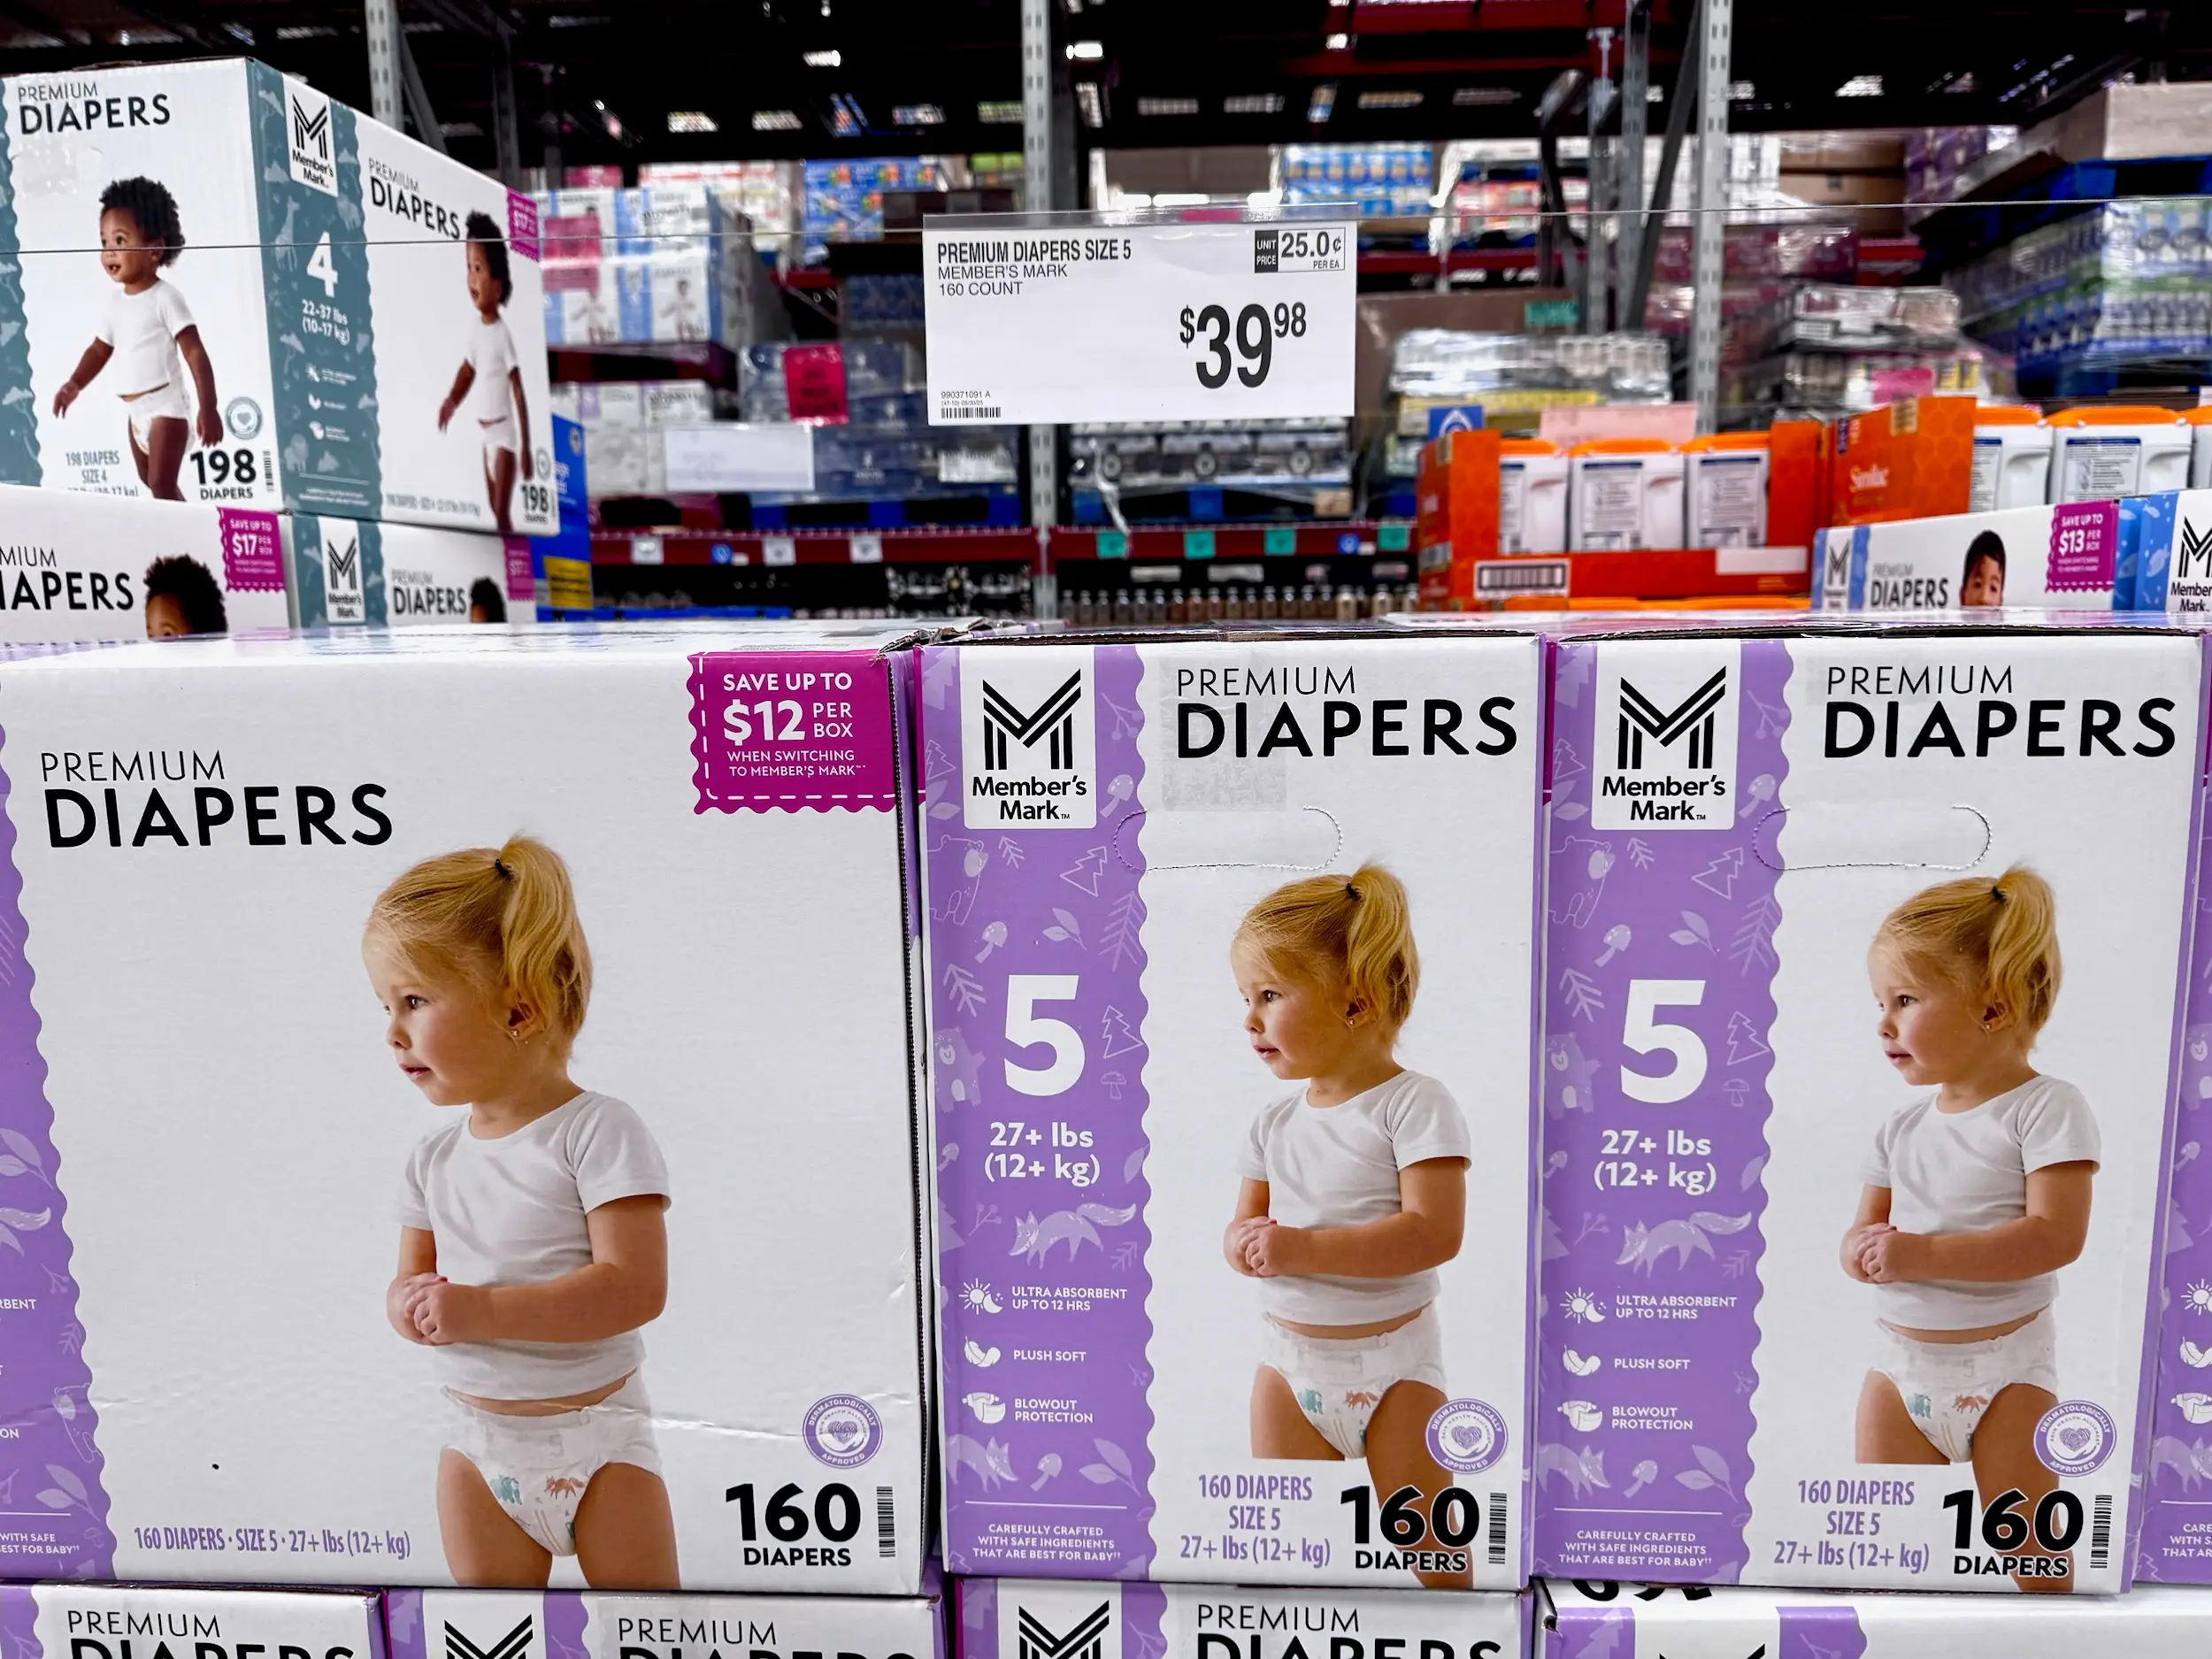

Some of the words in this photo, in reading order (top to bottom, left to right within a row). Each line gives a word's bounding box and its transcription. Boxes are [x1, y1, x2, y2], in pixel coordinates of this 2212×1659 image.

[18, 81, 98, 102] PREMIUM
[19, 94, 170, 134] DIAPERS
[292, 150, 334, 177] Member's
[369, 157, 419, 192] PREMIUM
[371, 177, 460, 239] DIAPERS
[938, 242, 1008, 263] PREMIUM
[1014, 240, 1080, 262] DIAPERS
[1085, 239, 1118, 260] SIZE
[1123, 240, 1131, 260] 5
[1256, 240, 1276, 250] UNIT
[307, 230, 338, 297] 4
[1256, 255, 1276, 265] PRICE
[1313, 260, 1327, 269] PER
[1329, 259, 1340, 269] EA
[938, 265, 1018, 280] MEMBER'S
[1023, 264, 1068, 278] MARK
[940, 283, 964, 296] 160
[969, 281, 1023, 296] COUNT
[302, 299, 331, 319] 22-37
[65, 451, 81, 466] 198
[82, 450, 119, 465] DIAPERS
[190, 449, 256, 486] 198
[81, 469, 99, 484] SIZE
[200, 488, 253, 501] DIAPERS
[521, 484, 549, 512] 198
[2061, 516, 2078, 527] SAVE
[2080, 514, 2092, 526] UP
[2093, 513, 2103, 524] TO
[232, 531, 257, 557] $17
[2058, 529, 2085, 557] $13
[390, 569, 433, 584] PREMIUM
[393, 588, 467, 616] DIAPERS
[1870, 577, 1948, 608] DIAPERS
[723, 673, 779, 691] SAVE
[785, 673, 816, 691] UP
[820, 672, 852, 690] TO
[1178, 666, 1356, 696] PREMIUM
[1827, 664, 2014, 695] PREMIUM
[813, 702, 852, 718] PER
[723, 699, 805, 746] $12
[813, 722, 853, 739] BOX
[1178, 697, 1517, 758] DIAPERS
[1824, 697, 2177, 758] DIAPERS
[41, 750, 225, 782] PREMIUM
[726, 750, 772, 762] WHEN
[775, 749, 855, 762] SWITCHING
[729, 766, 748, 777] TO
[750, 765, 814, 778] MEMBER'S
[972, 775, 1087, 798] Member's
[1601, 774, 1726, 799] Member's
[44, 783, 392, 849] DIAPERS
[1004, 975, 1086, 1096] 5
[1620, 979, 1708, 1103] 5
[990, 1122, 1041, 1146] 27+
[1052, 1122, 1094, 1147] lbs
[1601, 1130, 1656, 1155] 27+
[1667, 1130, 1711, 1156] lbs
[985, 1152, 1045, 1182] (12+
[1055, 1153, 1100, 1187] kg)
[1594, 1161, 1658, 1191] (12+
[1669, 1162, 1717, 1195] kg)
[1012, 1286, 1051, 1298] ULTRA
[1054, 1287, 1127, 1299] ABSORBENT
[1616, 1295, 1657, 1306] ULTRA
[1660, 1296, 1737, 1307] ABSORBENT
[1012, 1300, 1028, 1310] UP
[1031, 1301, 1050, 1310] TO
[1051, 1301, 1064, 1310] 12
[1066, 1301, 1091, 1311] HRS
[1616, 1309, 1633, 1318] UP
[1636, 1309, 1654, 1318] TO
[1658, 1310, 1670, 1319] 12
[1672, 1310, 1698, 1319] HRS
[1013, 1350, 1052, 1361] PLUSH
[1056, 1350, 1087, 1362] SOFT
[1614, 1358, 1655, 1369] PLUSH
[1658, 1359, 1691, 1370] SOFT
[808, 1399, 877, 1426] DERMATOLOGICALLY
[1014, 1399, 1077, 1410] BLOWOUT
[1612, 1407, 1678, 1417] BLOWOUT
[1015, 1411, 1093, 1423] PROTECTION
[1431, 1403, 1502, 1432] DERMATOLOGICALLY
[1611, 1418, 1693, 1430] PROTECTION
[2040, 1405, 2111, 1433] DERMATOLOGICALLY
[821, 1453, 865, 1465] APPROVED
[1442, 1458, 1488, 1470] APPROVED
[2050, 1460, 2095, 1472] APPROVED
[1198, 1473, 1231, 1499] 160
[1236, 1474, 1312, 1501] DIAPERS
[1798, 1479, 1832, 1504] 160
[1836, 1479, 1916, 1506] DIAPERS
[726, 1482, 861, 1542] 160
[1229, 1505, 1266, 1531] SIZE
[1271, 1507, 1280, 1532] 5
[1340, 1485, 1481, 1548] 160
[1826, 1510, 1866, 1536] SIZE
[1870, 1512, 1880, 1536] 5
[1942, 1487, 2085, 1553] 160
[30, 1533, 56, 1542] SAFE
[989, 1524, 1050, 1535] CAREFULLY
[1053, 1525, 1103, 1536] CRAFTED
[1577, 1531, 1640, 1541] CAREFULLY
[1644, 1532, 1696, 1542] CRAFTED
[2170, 1535, 2201, 1545] WITH
[22, 1545, 43, 1554] FOR
[134, 1526, 161, 1549] 160
[164, 1527, 226, 1551] DIAPERS
[235, 1529, 266, 1552] SIZE
[269, 1530, 278, 1551] 5
[289, 1530, 319, 1553] 27+
[323, 1531, 344, 1554] lbs
[347, 1531, 383, 1556] (12+
[387, 1531, 411, 1559] kg)
[978, 1536, 1008, 1547] WITH
[1011, 1537, 1037, 1547] SAFE
[1040, 1538, 1115, 1548] INGREDIENTS
[1180, 1534, 1217, 1559] 27+
[1223, 1535, 1248, 1560] lbs
[1253, 1536, 1296, 1563] (12+
[1302, 1537, 1331, 1568] kg)
[1565, 1542, 1596, 1552] WITH
[1599, 1543, 1626, 1553] SAFE
[1629, 1544, 1707, 1555] INGREDIENTS
[2162, 1548, 2195, 1557] THAT
[743, 1548, 851, 1566] DIAPERS
[973, 1548, 1002, 1558] THAT
[1005, 1548, 1026, 1559] ARE
[1029, 1549, 1056, 1559] BEST
[1059, 1549, 1081, 1560] FOR
[1355, 1549, 1467, 1571] DIAPERS
[1559, 1554, 1590, 1564] THAT
[1593, 1555, 1614, 1565] ARE
[1617, 1555, 1645, 1565] BEST
[1648, 1556, 1671, 1566] FOR
[1774, 1541, 1813, 1566] 27+
[1817, 1541, 1844, 1567] lbs
[1848, 1542, 1895, 1571] (12+
[1899, 1543, 1930, 1574] kg)
[1953, 1555, 2068, 1578] DIAPERS
[68, 1610, 220, 1638] PREMIUM
[1198, 1604, 1359, 1632] PREMIUM
[618, 1617, 776, 1645] PREMIUM
